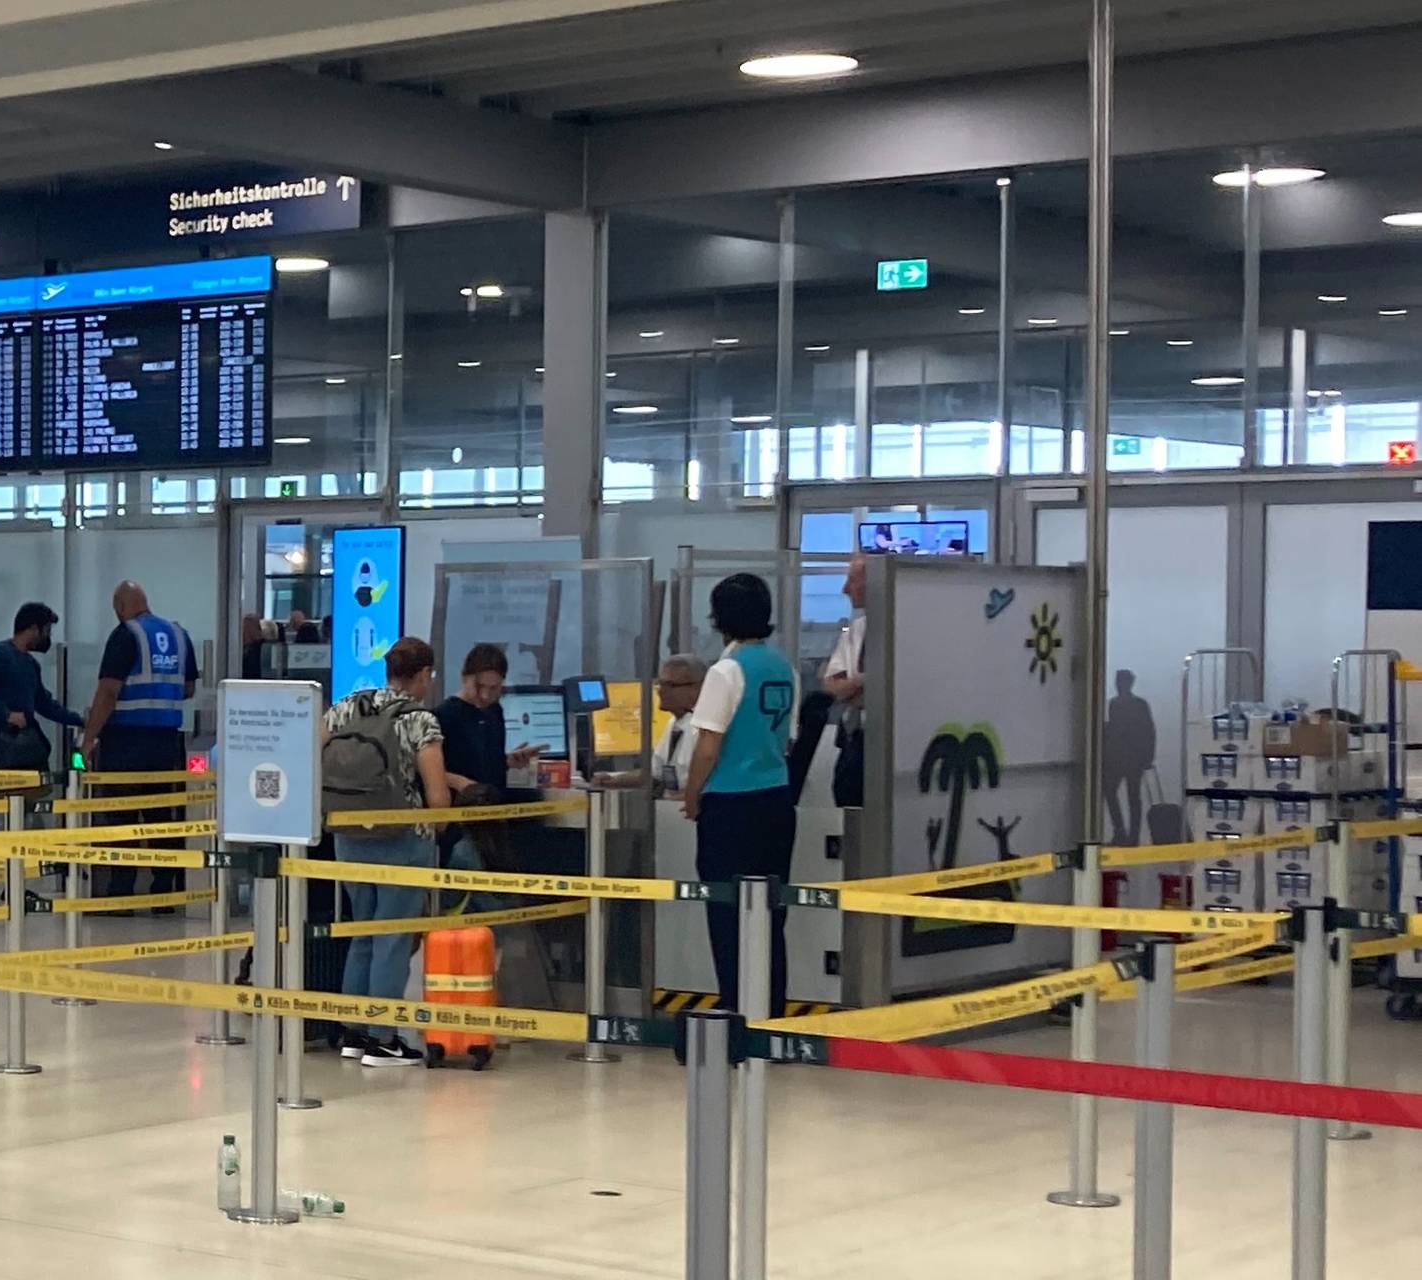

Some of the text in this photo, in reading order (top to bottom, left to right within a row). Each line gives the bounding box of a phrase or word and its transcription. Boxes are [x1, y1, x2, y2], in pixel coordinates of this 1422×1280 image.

[169, 177, 326, 211] Sicherheitskontrolle
[169, 208, 273, 236] Security check
[267, 997, 360, 1017] Köln Bonn Airport
[436, 1011, 538, 1031] Köln Bonn Airport
